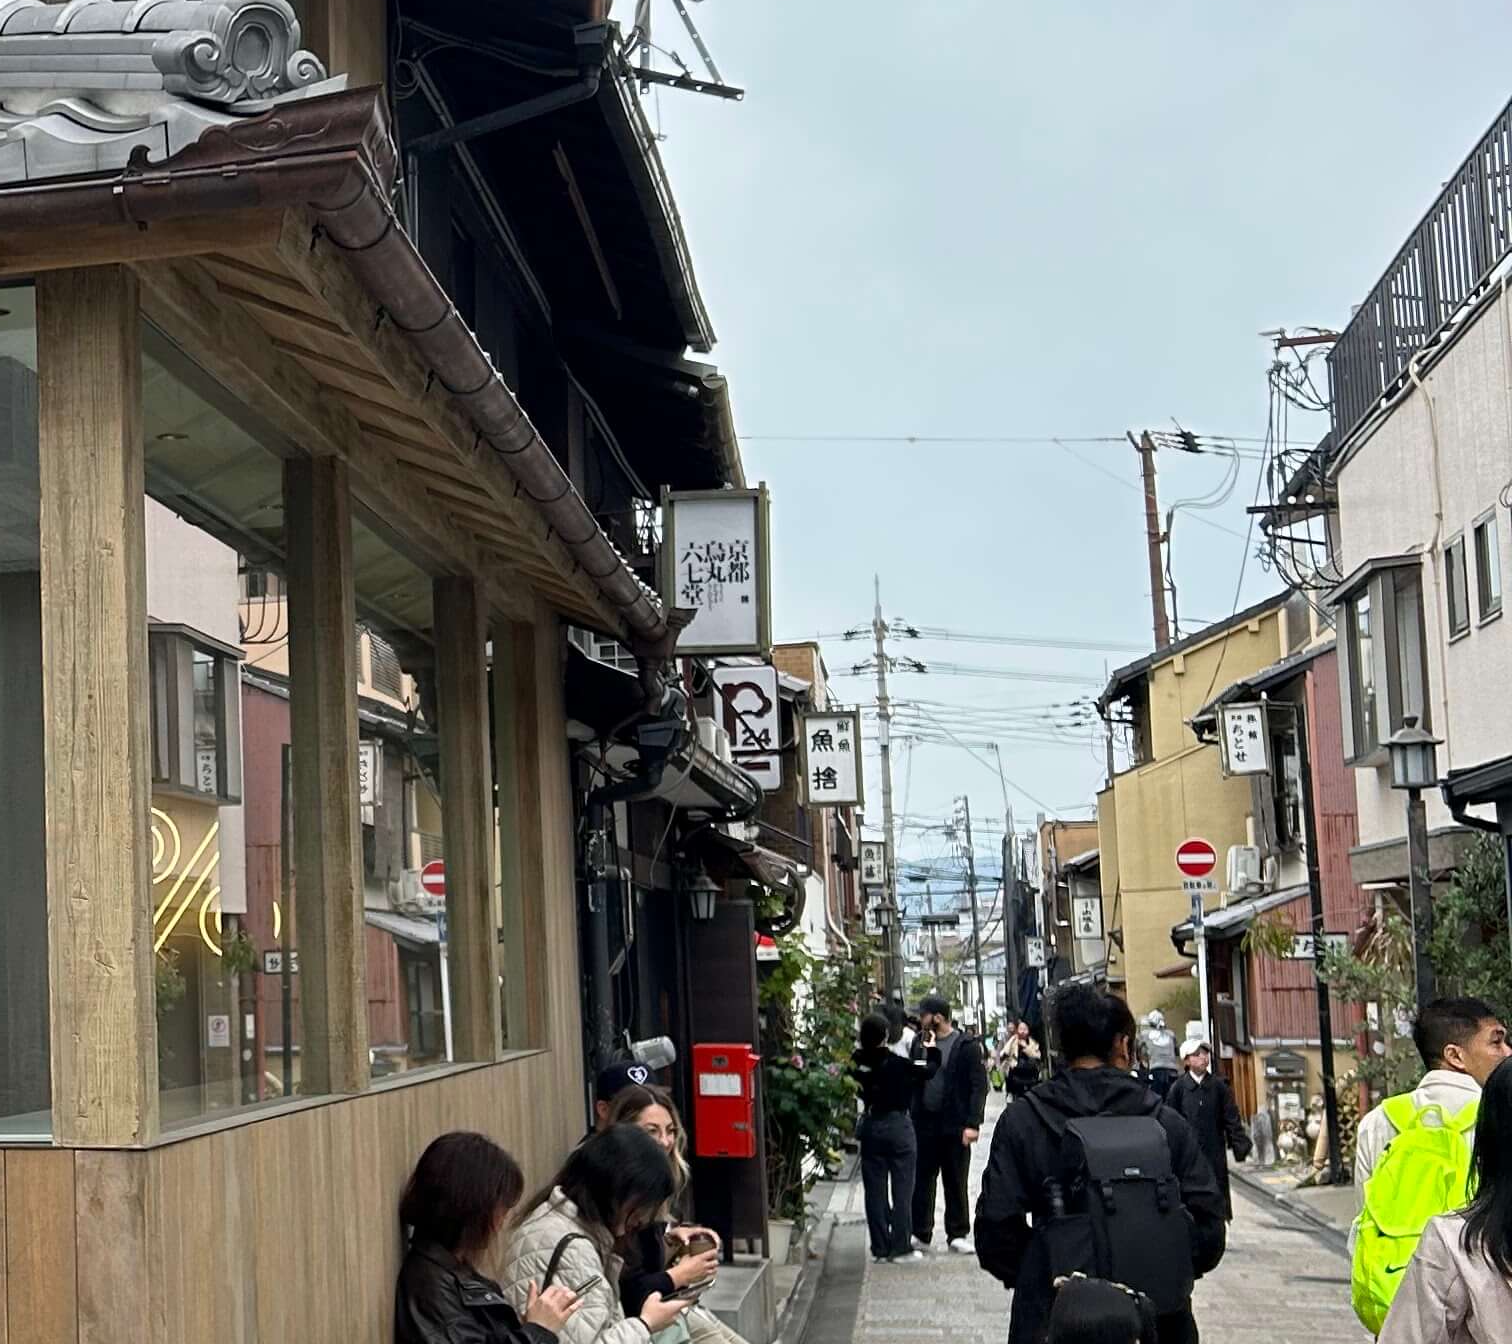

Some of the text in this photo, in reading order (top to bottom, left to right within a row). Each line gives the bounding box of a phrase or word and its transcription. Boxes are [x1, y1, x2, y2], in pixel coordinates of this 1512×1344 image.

[681, 541, 704, 606] 六七堂
[728, 539, 750, 584] 京都
[741, 727, 772, 747] 24
